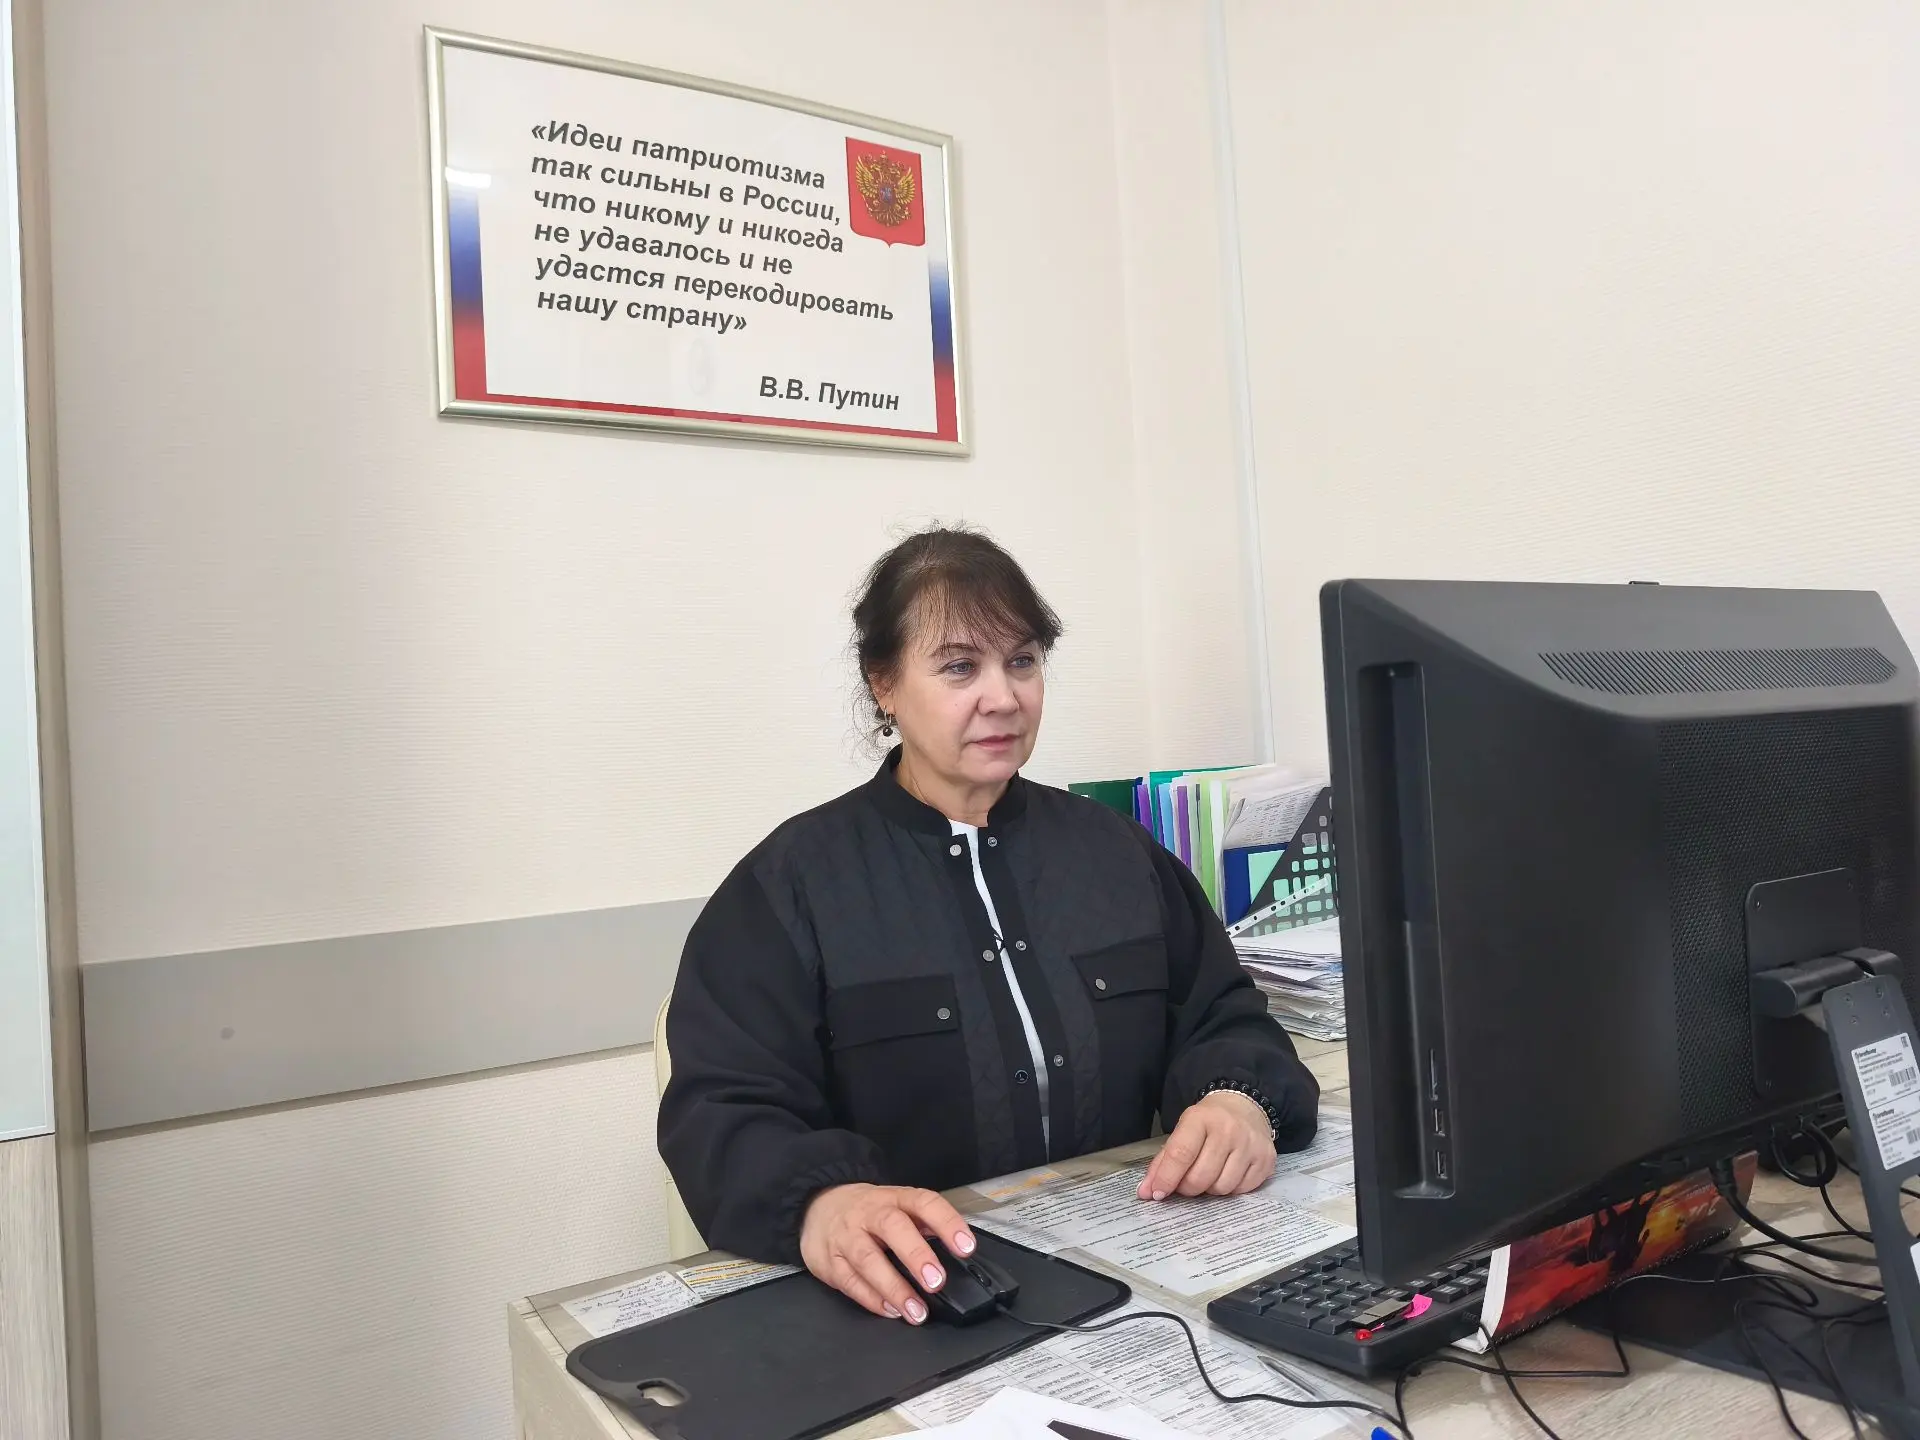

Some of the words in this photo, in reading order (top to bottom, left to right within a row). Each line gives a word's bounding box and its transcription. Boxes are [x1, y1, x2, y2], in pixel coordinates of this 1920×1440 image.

[531, 120, 623, 153] «Идеи
[631, 139, 825, 189] патриотизма
[531, 156, 593, 181] так
[600, 167, 711, 199] сильны
[719, 186, 734, 203] в
[743, 184, 840, 226] России,
[534, 190, 596, 214] что
[605, 200, 711, 236] никому
[718, 217, 734, 235] и
[742, 221, 843, 253] никогда
[534, 223, 570, 244] не
[578, 225, 731, 266] удавалось
[739, 252, 754, 270] и
[762, 256, 793, 275] не
[535, 253, 665, 289] удастся
[674, 275, 894, 321] перекодировать
[537, 291, 618, 322] нашу
[626, 301, 747, 335] страну»
[759, 375, 810, 402] В.В.
[818, 382, 900, 411] Путин
